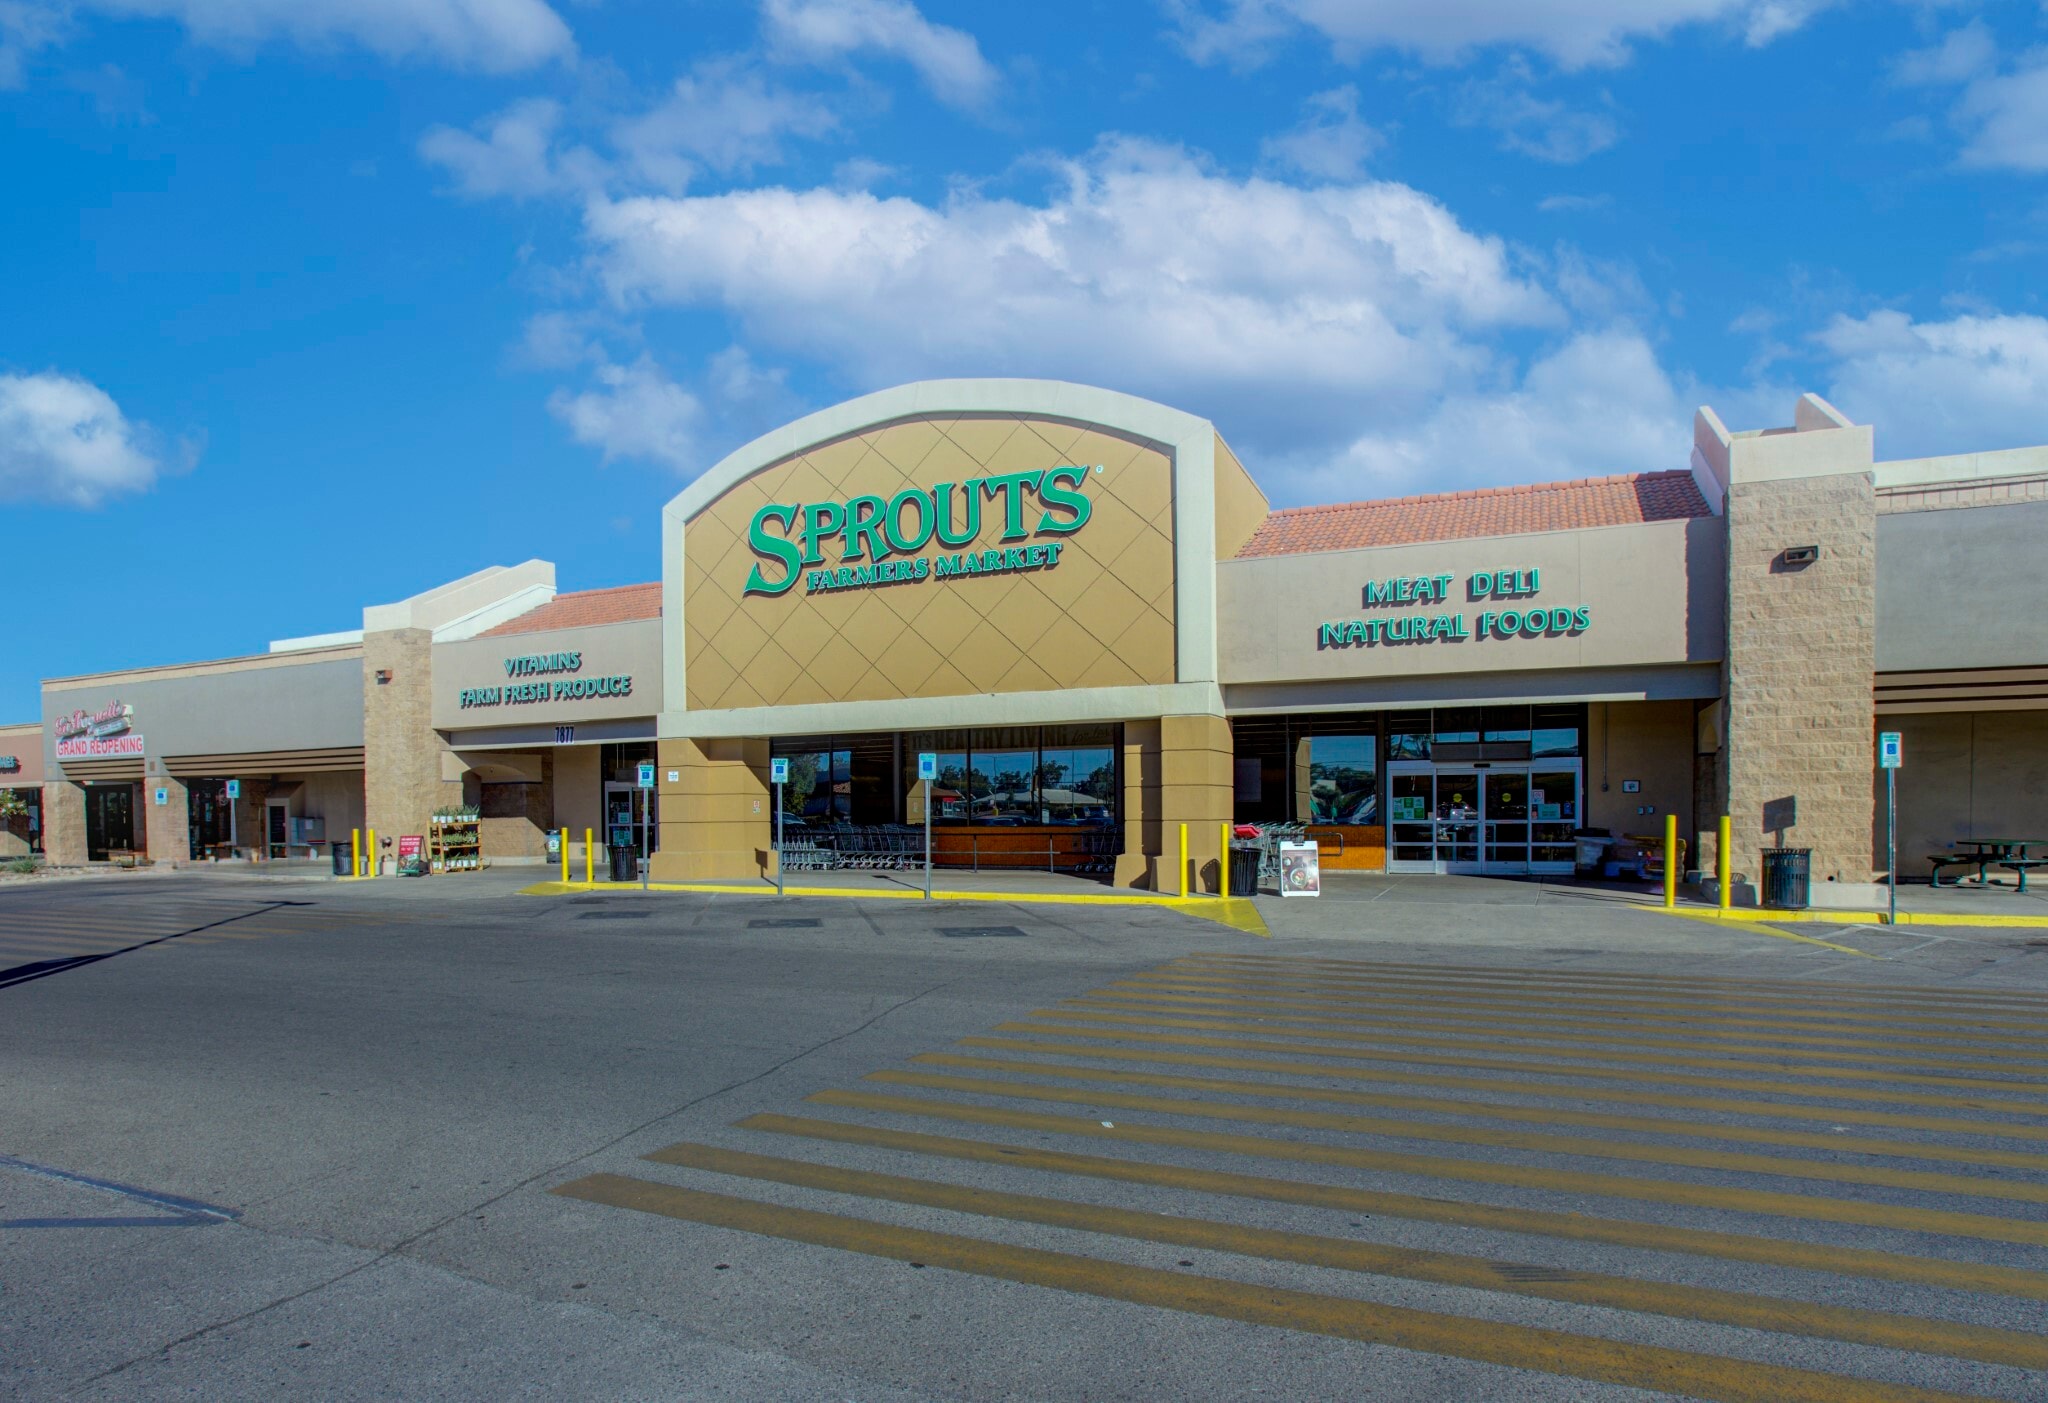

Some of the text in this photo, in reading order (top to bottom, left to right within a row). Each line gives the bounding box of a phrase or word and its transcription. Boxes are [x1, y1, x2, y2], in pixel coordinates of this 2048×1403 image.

[744, 465, 1092, 593] SPROUTS
[806, 542, 1062, 591] FARMERS MARKET
[1366, 567, 1540, 603] MEAT DELI
[1321, 605, 1591, 645] NATURAL FOODS
[503, 651, 581, 675] VITAMINS
[459, 675, 632, 706] FARM FRESH PRODUCE
[57, 736, 143, 755] GRAND REOPENING
[555, 726, 574, 744] 7877
[935, 727, 1003, 749] HEATHY
[1010, 725, 1067, 747] LIVNG
